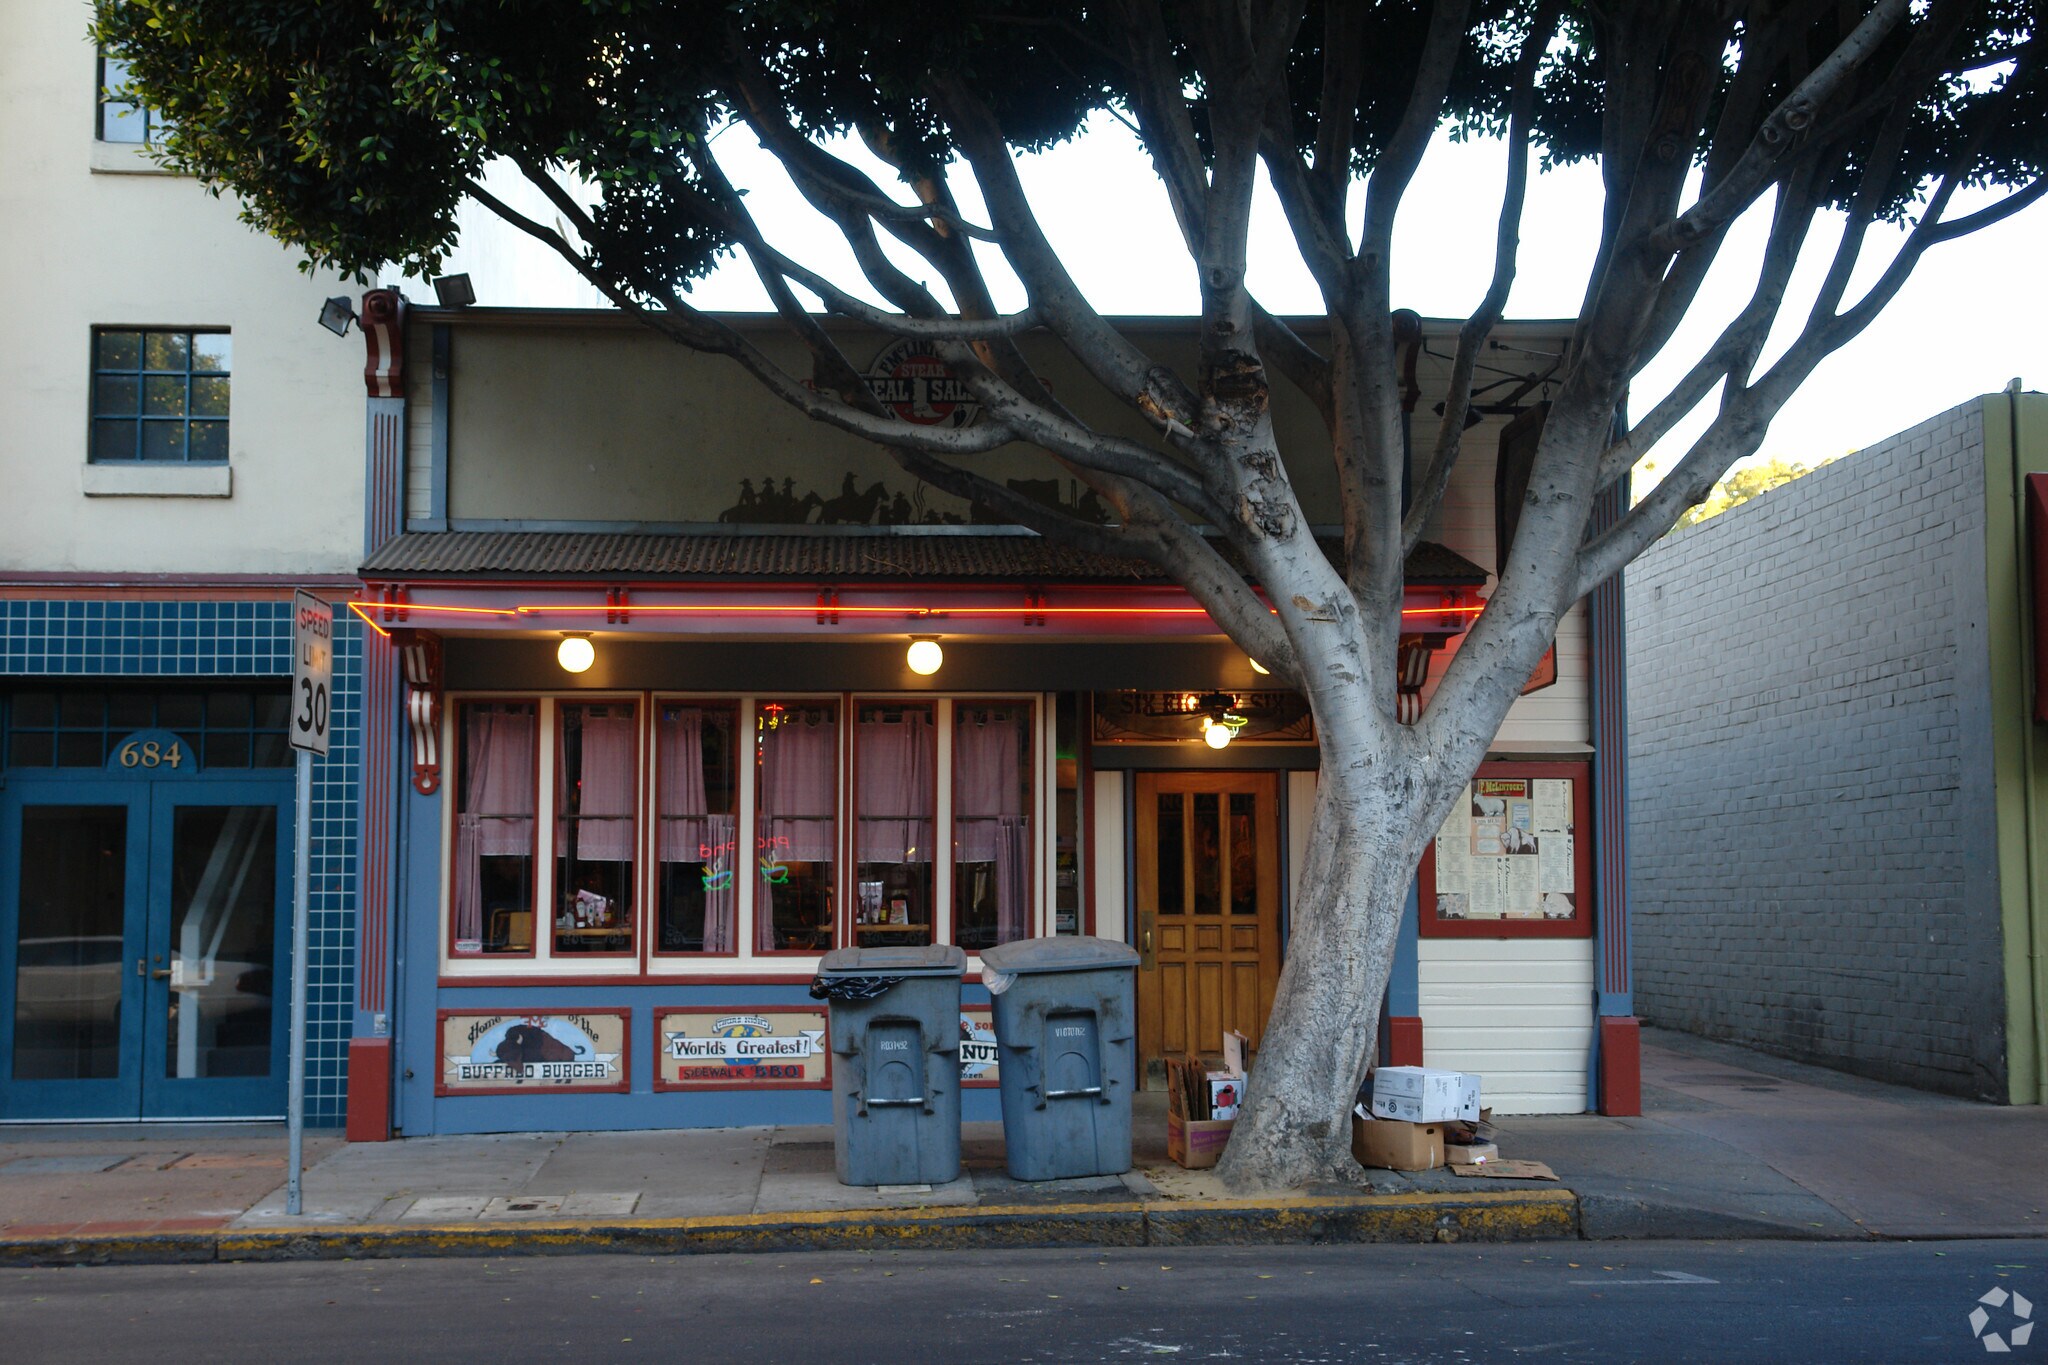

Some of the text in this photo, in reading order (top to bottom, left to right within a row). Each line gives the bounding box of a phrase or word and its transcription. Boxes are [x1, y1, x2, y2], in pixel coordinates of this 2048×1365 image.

[874, 379, 977, 402] EAL SAL
[301, 607, 329, 639] SPEED
[303, 643, 326, 672] LIMIT
[297, 677, 327, 736] 30
[1120, 693, 1155, 714] SIX
[120, 741, 182, 768] 684
[468, 1014, 600, 1046] Home of the
[675, 1040, 809, 1056] World's Greatest!
[542, 1063, 606, 1079] BURGER
[684, 1065, 800, 1080] SIDEWALK BBQ
